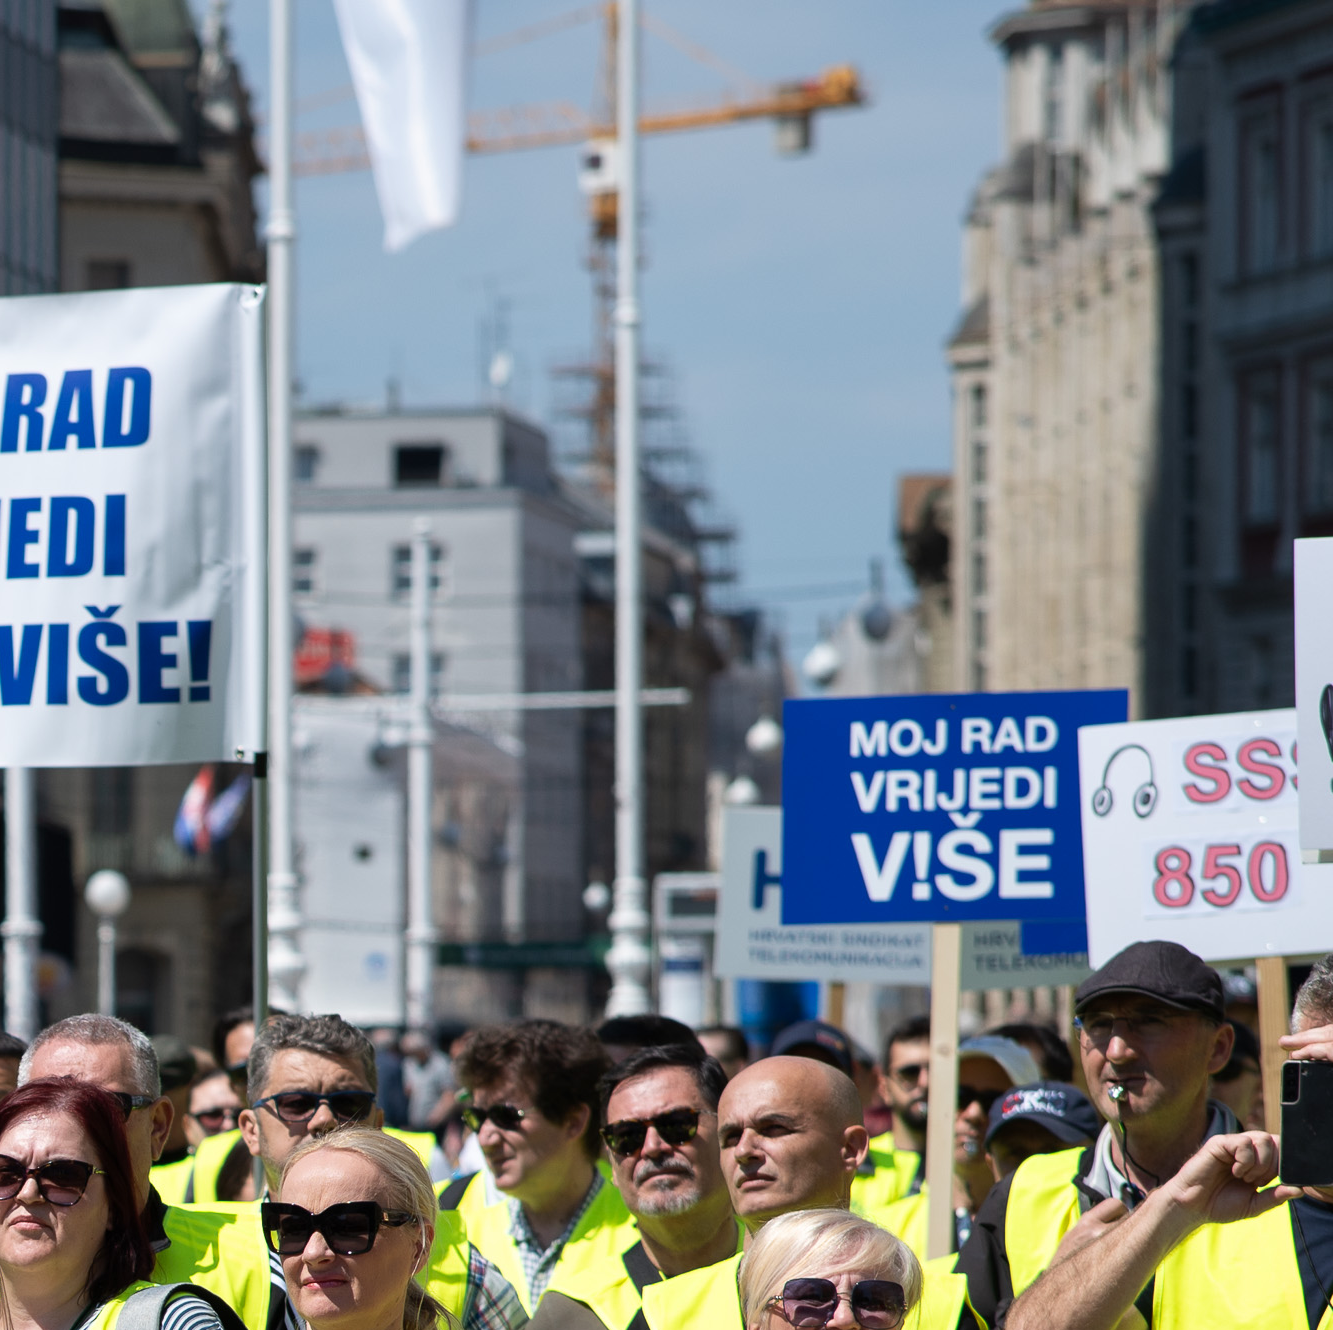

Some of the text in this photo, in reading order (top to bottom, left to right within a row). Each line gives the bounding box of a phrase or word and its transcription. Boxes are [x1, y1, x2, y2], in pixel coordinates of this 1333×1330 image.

[0, 366, 152, 453] RAD
[849, 716, 1059, 758] MOJ RAD
[849, 766, 1058, 813] VRIJEDI
[1182, 738, 1298, 806] SS
[850, 812, 1054, 902] V!ŠE
[1151, 841, 1290, 909] 850
